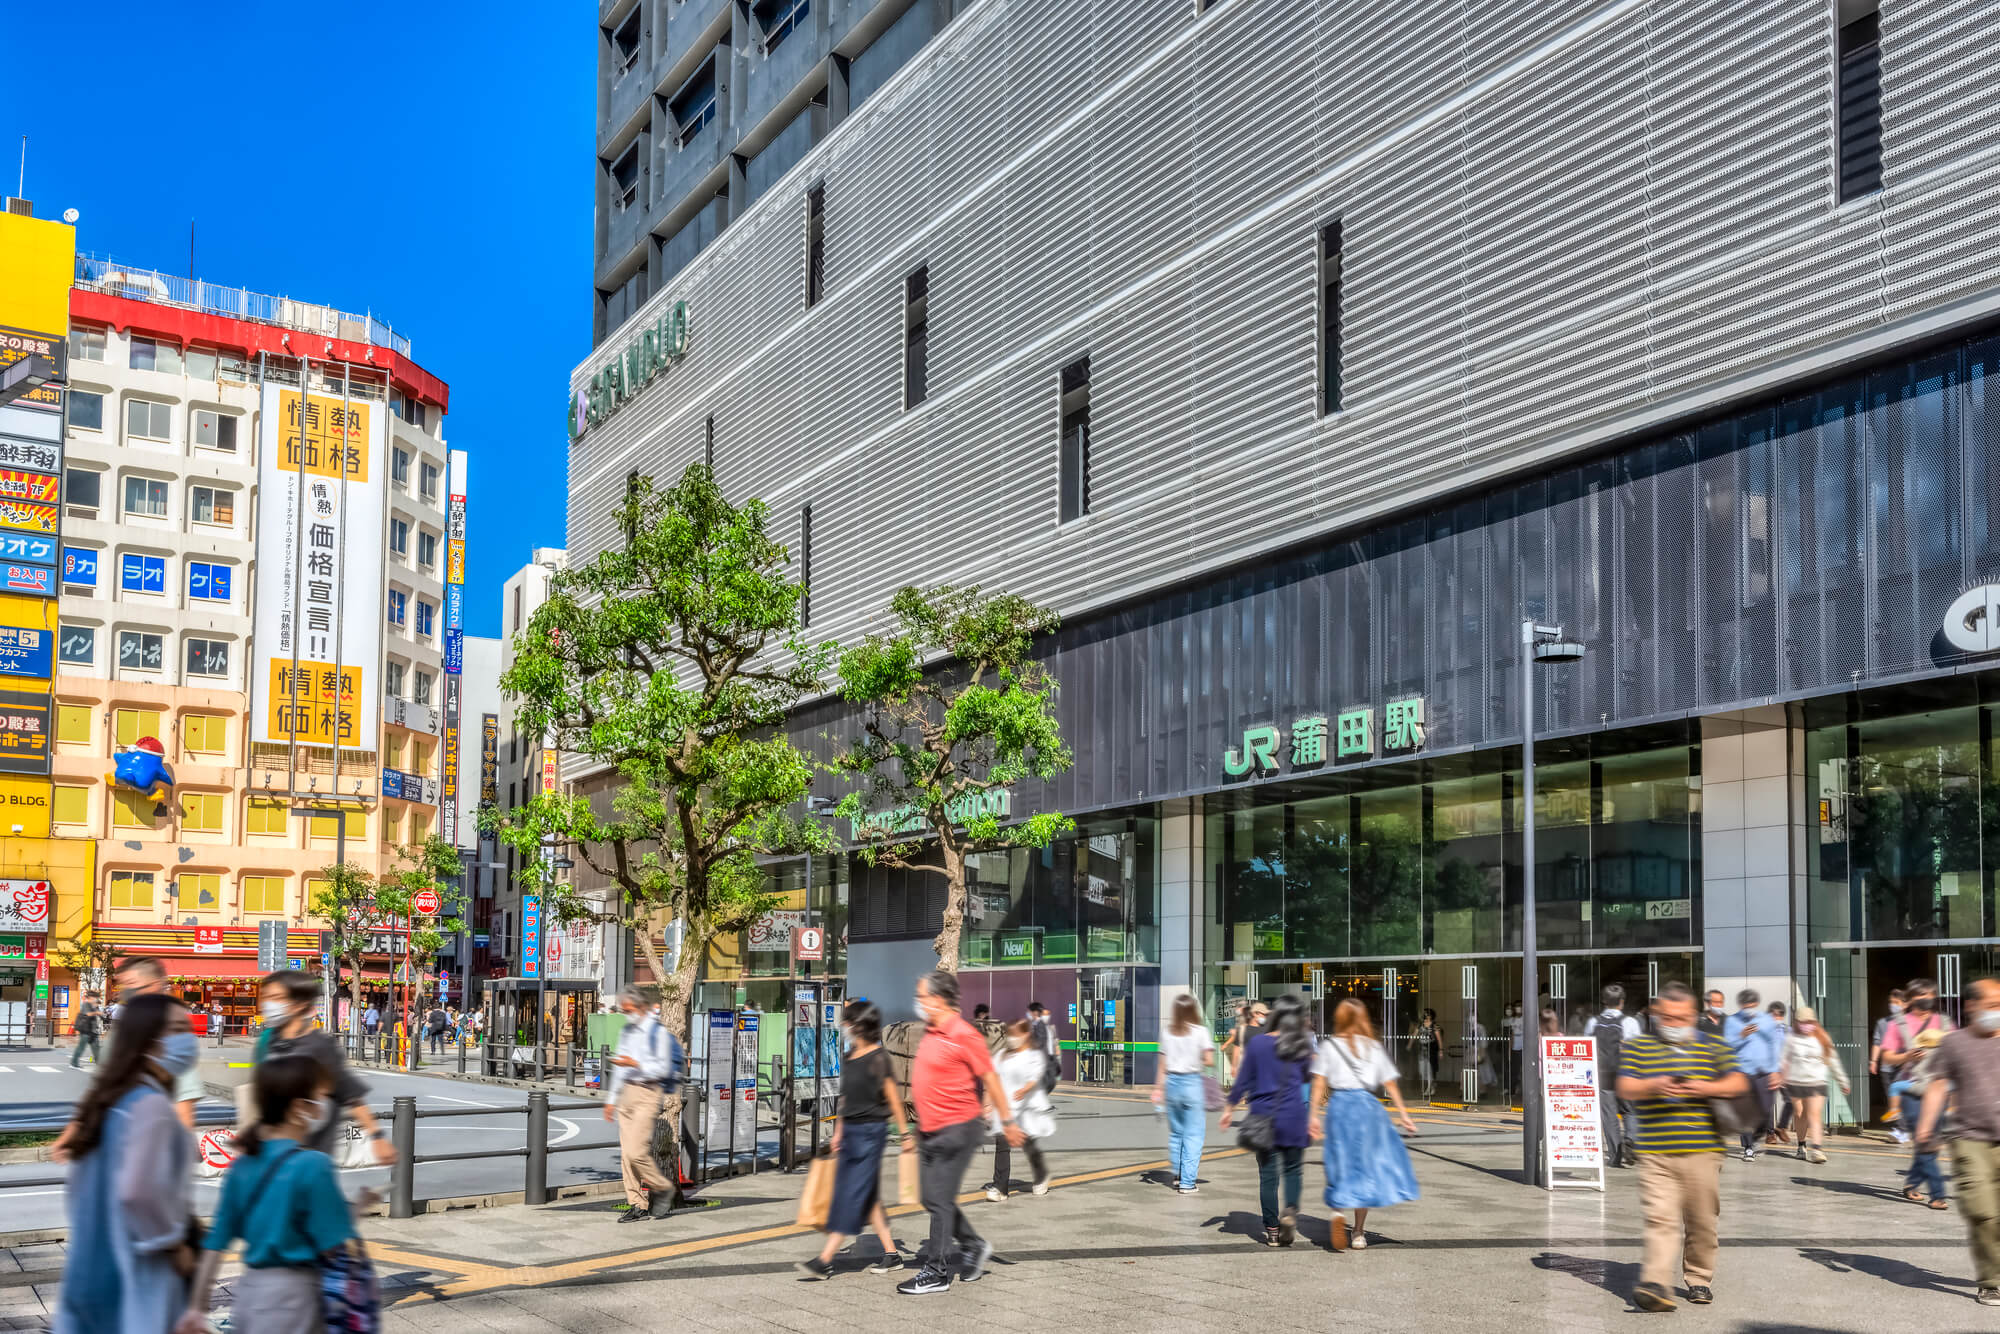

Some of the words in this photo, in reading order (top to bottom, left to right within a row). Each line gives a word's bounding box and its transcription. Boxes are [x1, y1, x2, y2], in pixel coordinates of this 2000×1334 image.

[21, 388, 60, 403] 業中!
[287, 399, 361, 437] 情熱
[286, 436, 361, 474] 価格
[31, 483, 45, 496] 7F
[66, 555, 75, 575] 6F
[8, 567, 47, 581] お入口
[450, 592, 461, 623] カラオケ
[21, 631, 38, 646] 5F
[278, 666, 354, 701] 情熱
[277, 704, 353, 739] 価格
[10, 795, 48, 807] BLDG.
[29, 939, 42, 948] B1
[525, 901, 538, 972] カラオケ館
[1551, 1042, 1588, 1057] 献血
